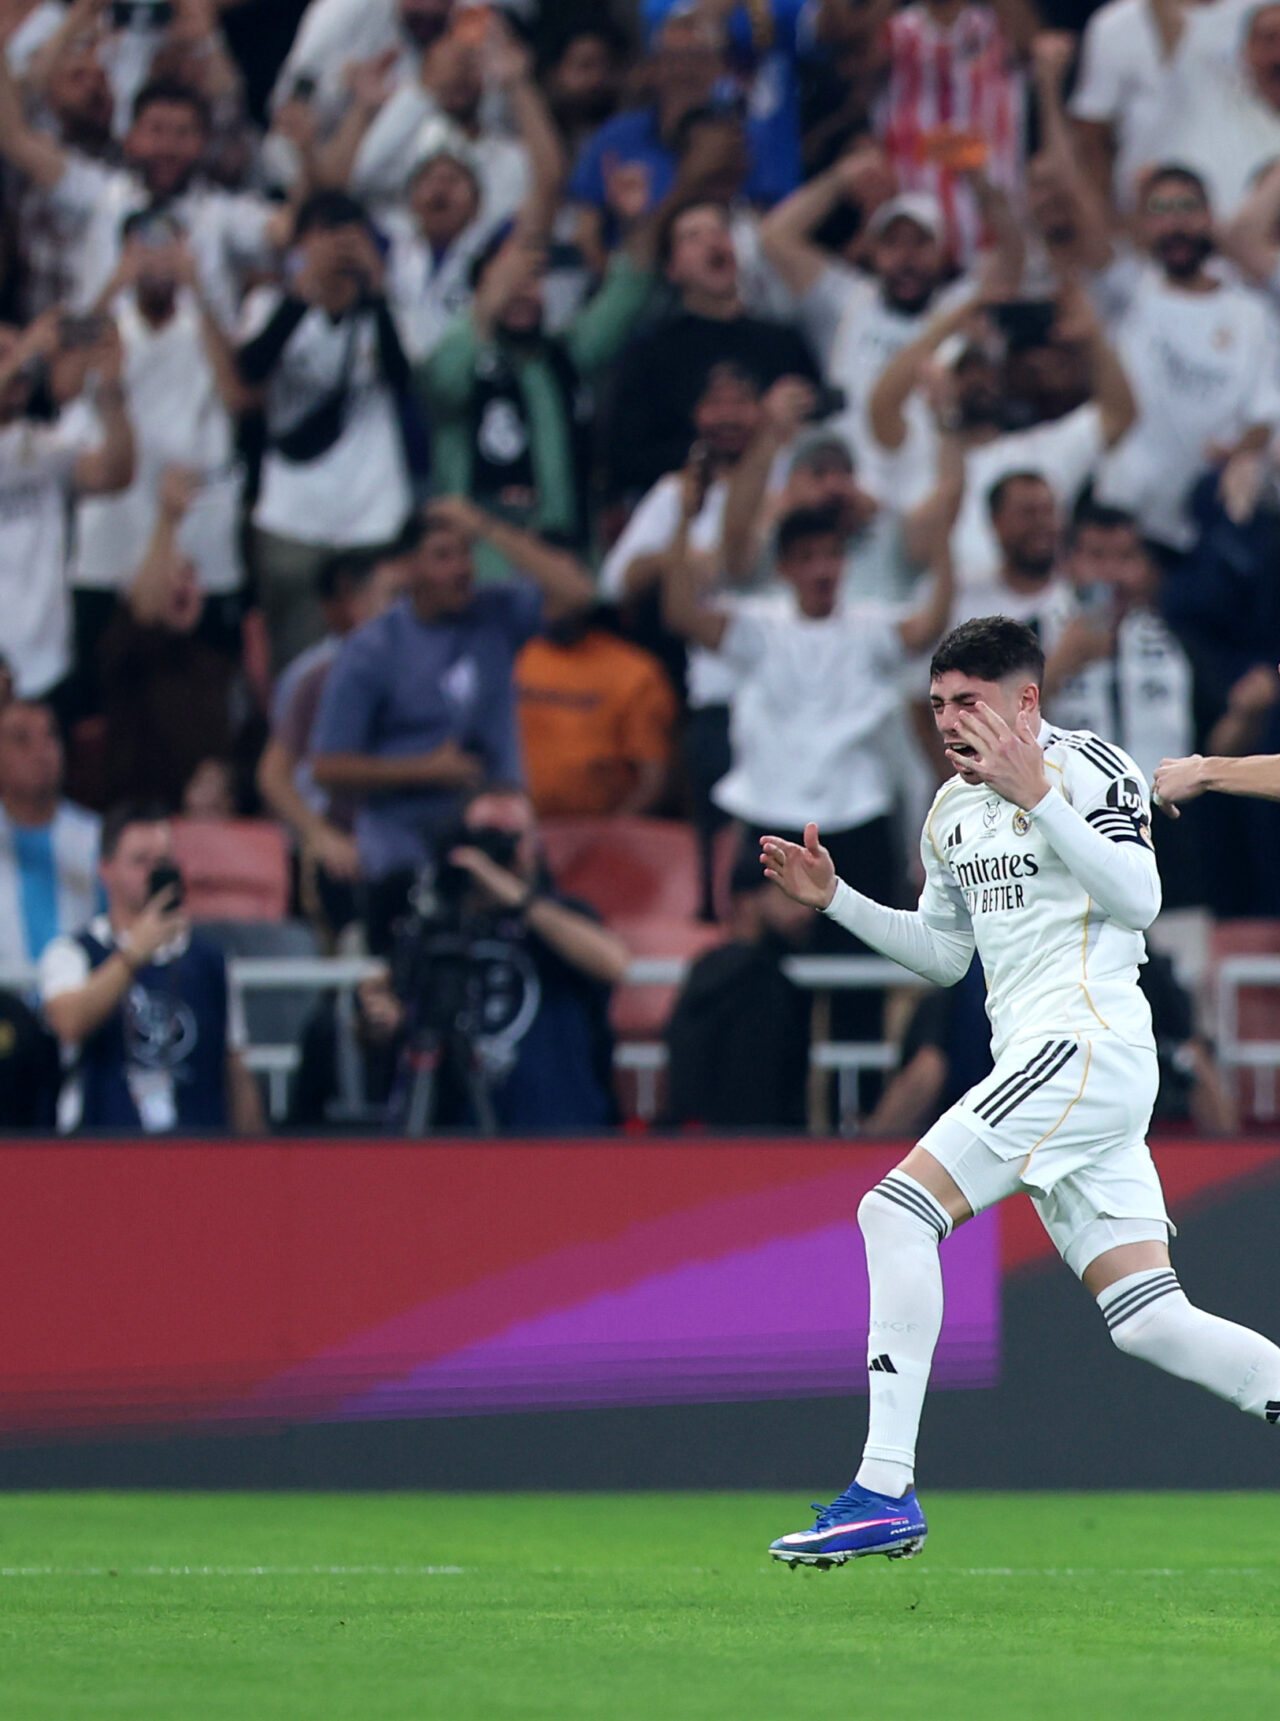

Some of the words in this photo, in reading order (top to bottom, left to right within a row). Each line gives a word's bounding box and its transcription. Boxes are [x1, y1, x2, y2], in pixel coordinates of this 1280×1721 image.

[1116, 777, 1147, 819] hp
[949, 852, 1039, 888] Emirates
[982, 884, 1024, 914] BETTER
